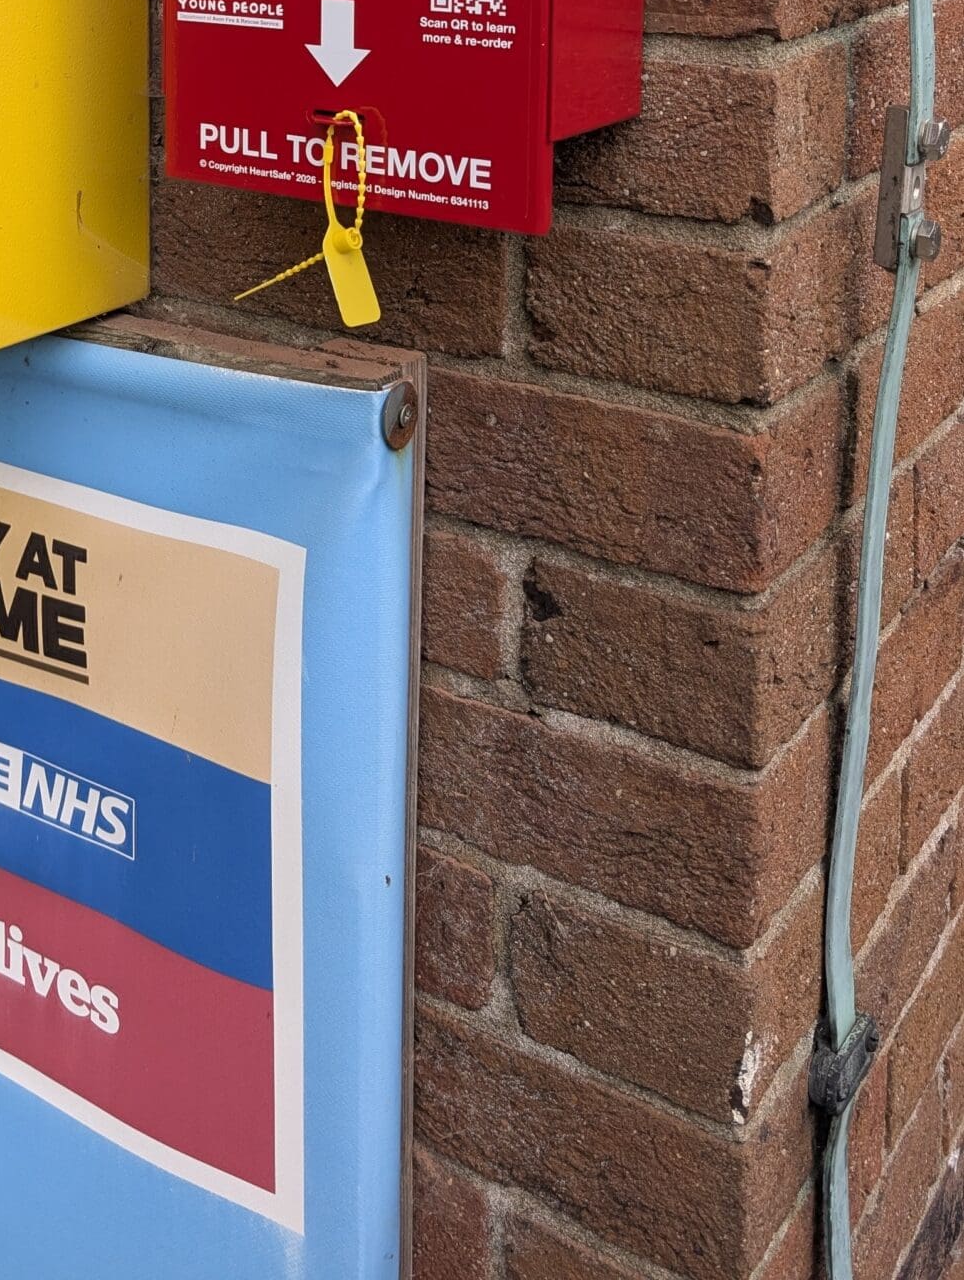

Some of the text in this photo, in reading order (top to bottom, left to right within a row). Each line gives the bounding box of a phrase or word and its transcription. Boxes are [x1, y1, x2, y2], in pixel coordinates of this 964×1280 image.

[232, 1, 284, 16] PEOPLE
[420, 17, 516, 34] Scan QR to learn
[423, 34, 513, 49] more & re-order
[200, 122, 492, 190] PULL TO REMOVE
[208, 160, 248, 175] Copyright
[296, 173, 316, 184] 2026
[374, 185, 406, 198] Design
[408, 190, 449, 204] Number:
[450, 195, 489, 210] 6341113
[16, 532, 87, 595] AT
[23, 762, 129, 846] NHS
